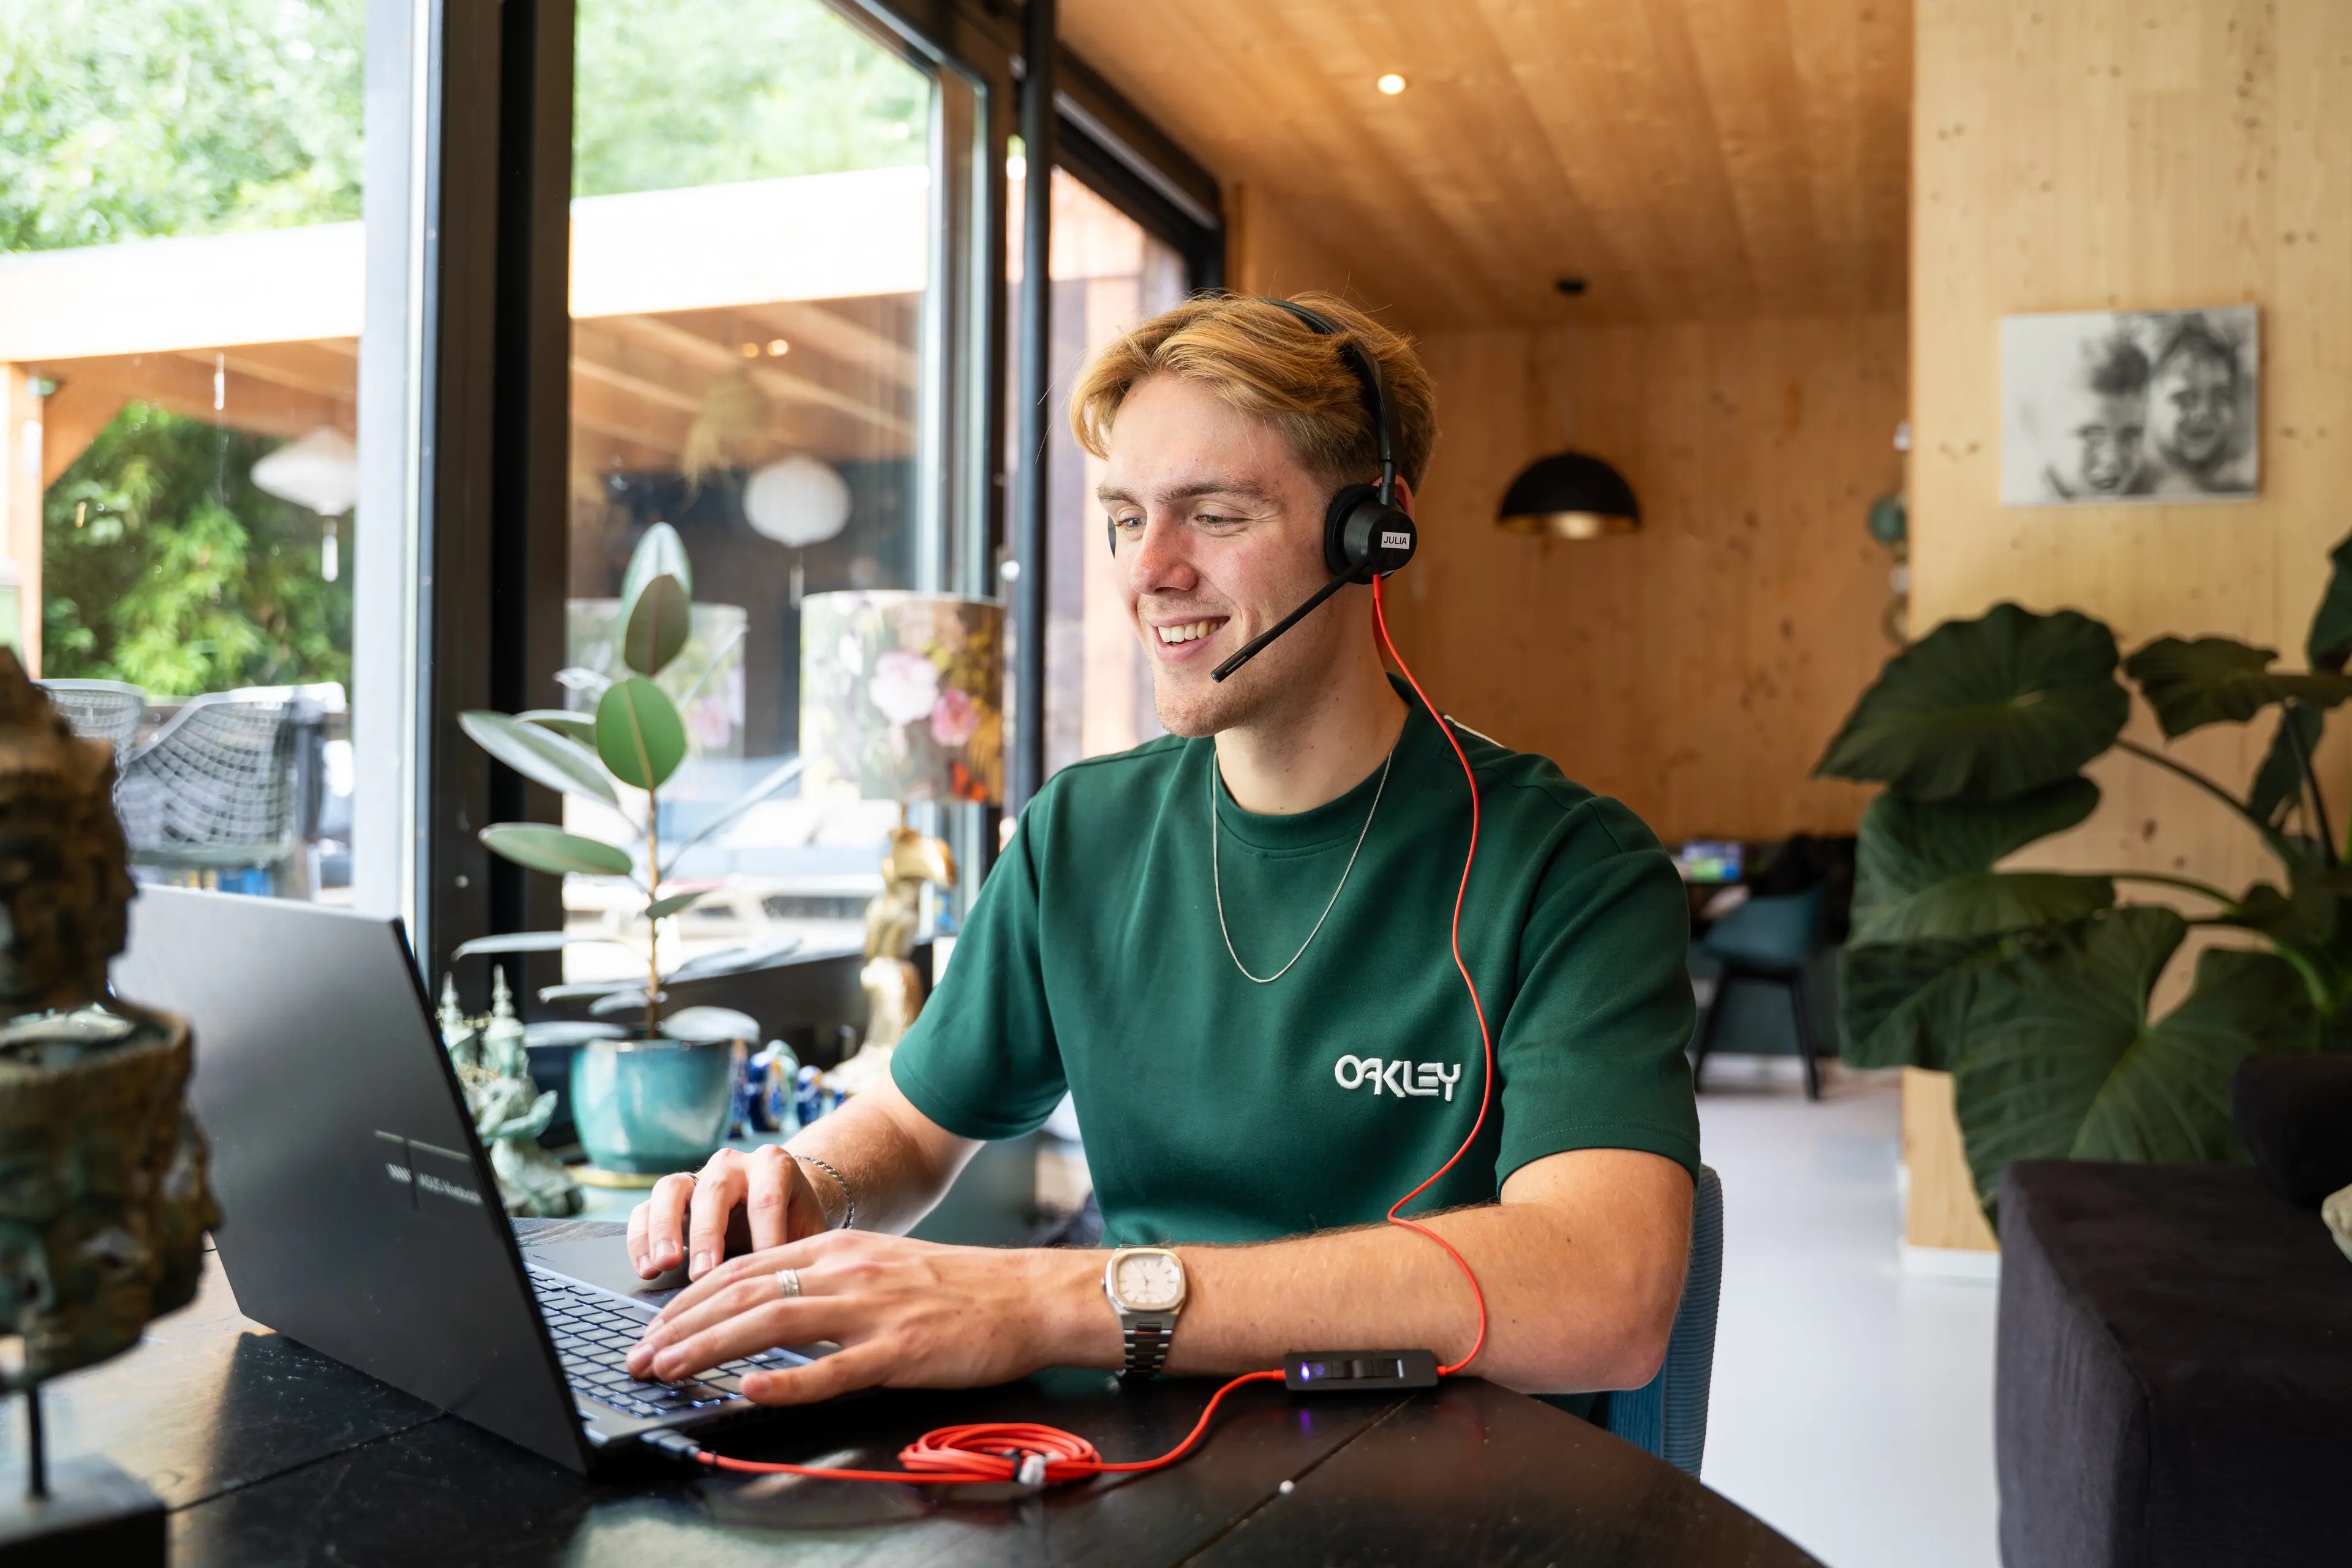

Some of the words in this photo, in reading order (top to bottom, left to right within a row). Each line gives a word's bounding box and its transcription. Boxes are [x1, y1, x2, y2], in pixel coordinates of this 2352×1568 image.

[1384, 536, 1407, 545] JULIA
[1335, 1054, 1461, 1102] OAKLEY
[418, 1172, 444, 1194] ASUS
